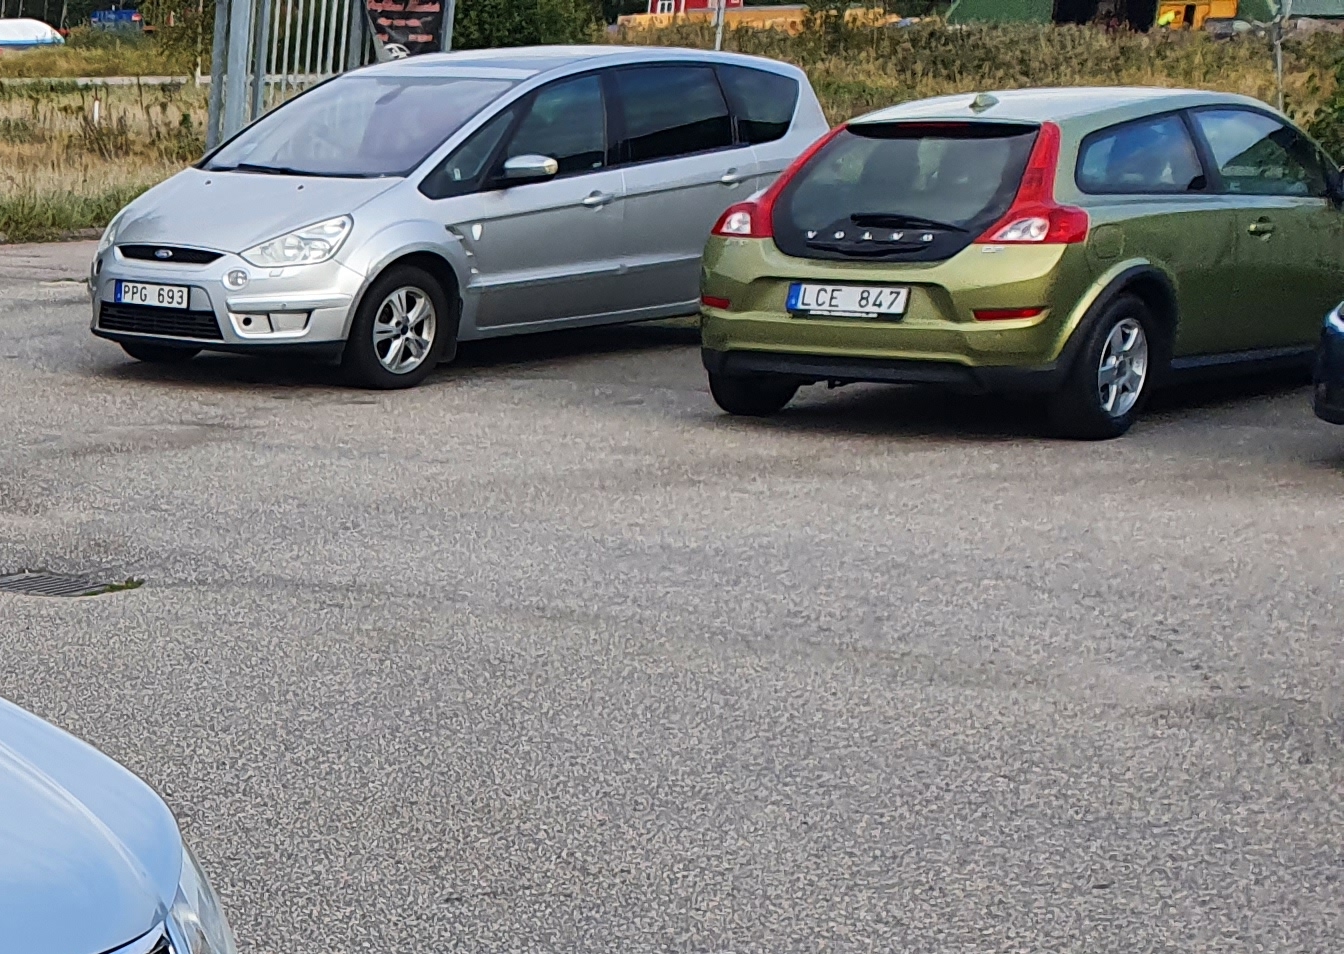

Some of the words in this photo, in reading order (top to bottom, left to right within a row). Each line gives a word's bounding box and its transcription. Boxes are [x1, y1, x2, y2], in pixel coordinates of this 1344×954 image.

[806, 230, 934, 241] VOLVO
[123, 284, 148, 303] PPG
[157, 287, 184, 306] 693
[801, 287, 843, 308] LCE
[858, 289, 901, 310] 847
